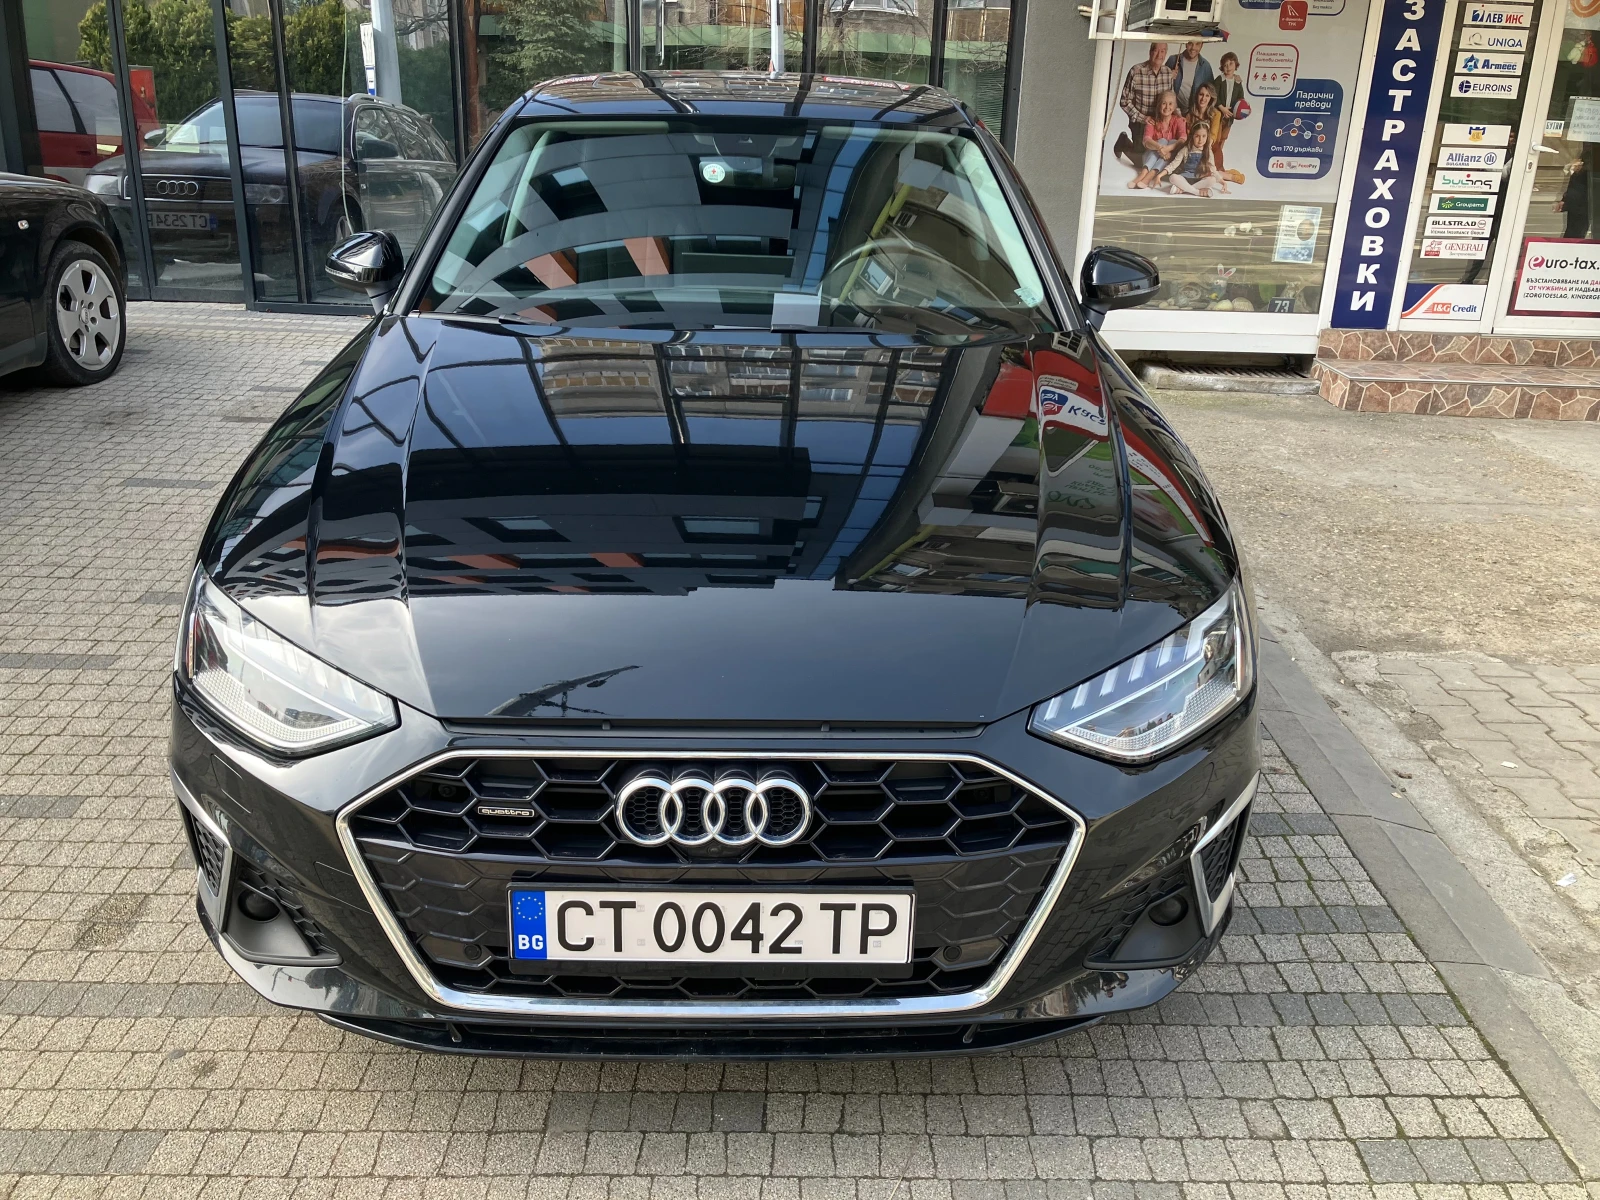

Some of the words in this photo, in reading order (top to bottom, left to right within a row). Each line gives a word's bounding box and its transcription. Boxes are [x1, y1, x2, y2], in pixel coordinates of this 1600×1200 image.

[1485, 13, 1503, 23] ЛЕВ
[1505, 14, 1524, 24] ИНС
[1487, 37, 1523, 48] UNIQA
[1481, 59, 1517, 71] Armeec
[1472, 83, 1513, 93] EUROINS
[1296, 90, 1334, 100] Парични
[1294, 100, 1332, 109] преводи
[1350, 0, 1426, 312] ЗАСТРАХОВКИ
[1446, 153, 1482, 163] Allianz
[1271, 160, 1284, 169] ria
[1444, 243, 1485, 252] GENERALI
[1526, 277, 1580, 285] ВЪЗСТАНОВЯВАНЕ
[1274, 300, 1290, 312] 73
[1433, 303, 1451, 312] I&G
[1452, 304, 1477, 313] Credit
[481, 808, 530, 816] quattro
[557, 900, 637, 953] CT
[652, 901, 804, 954] 0042
[819, 902, 898, 955] TP
[517, 934, 544, 950] BG
